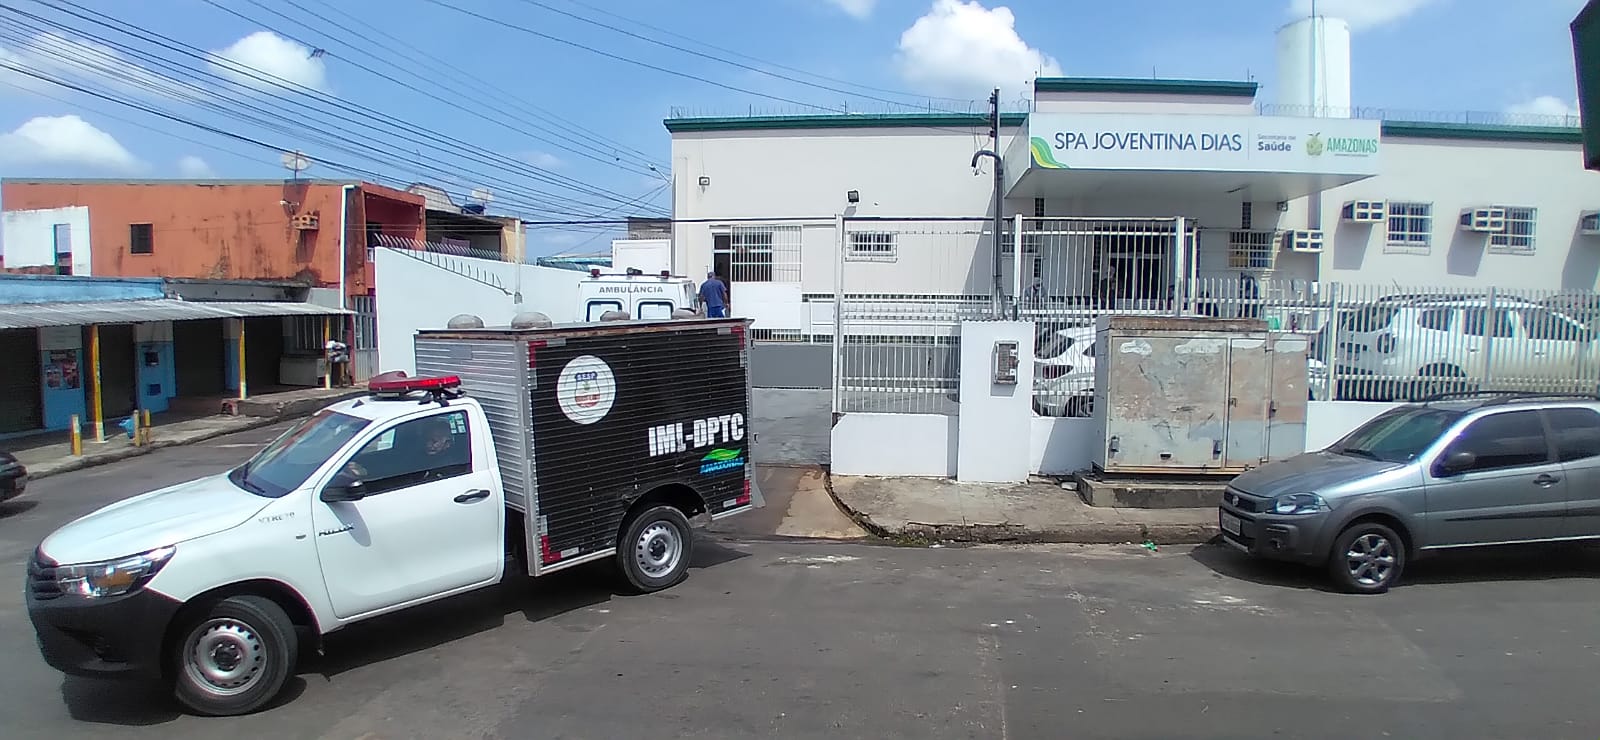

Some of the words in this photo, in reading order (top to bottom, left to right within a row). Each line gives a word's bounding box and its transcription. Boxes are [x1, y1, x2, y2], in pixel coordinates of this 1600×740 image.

[1054, 132, 1088, 150] SPA
[1092, 133, 1197, 151] JOVENTINA
[1201, 134, 1242, 152] DIAS
[1257, 141, 1292, 152] Saúde
[1327, 137, 1378, 154] AMAZONAS
[599, 285, 664, 294] AMBULÂNCIA
[648, 412, 744, 457] IML-DPTC
